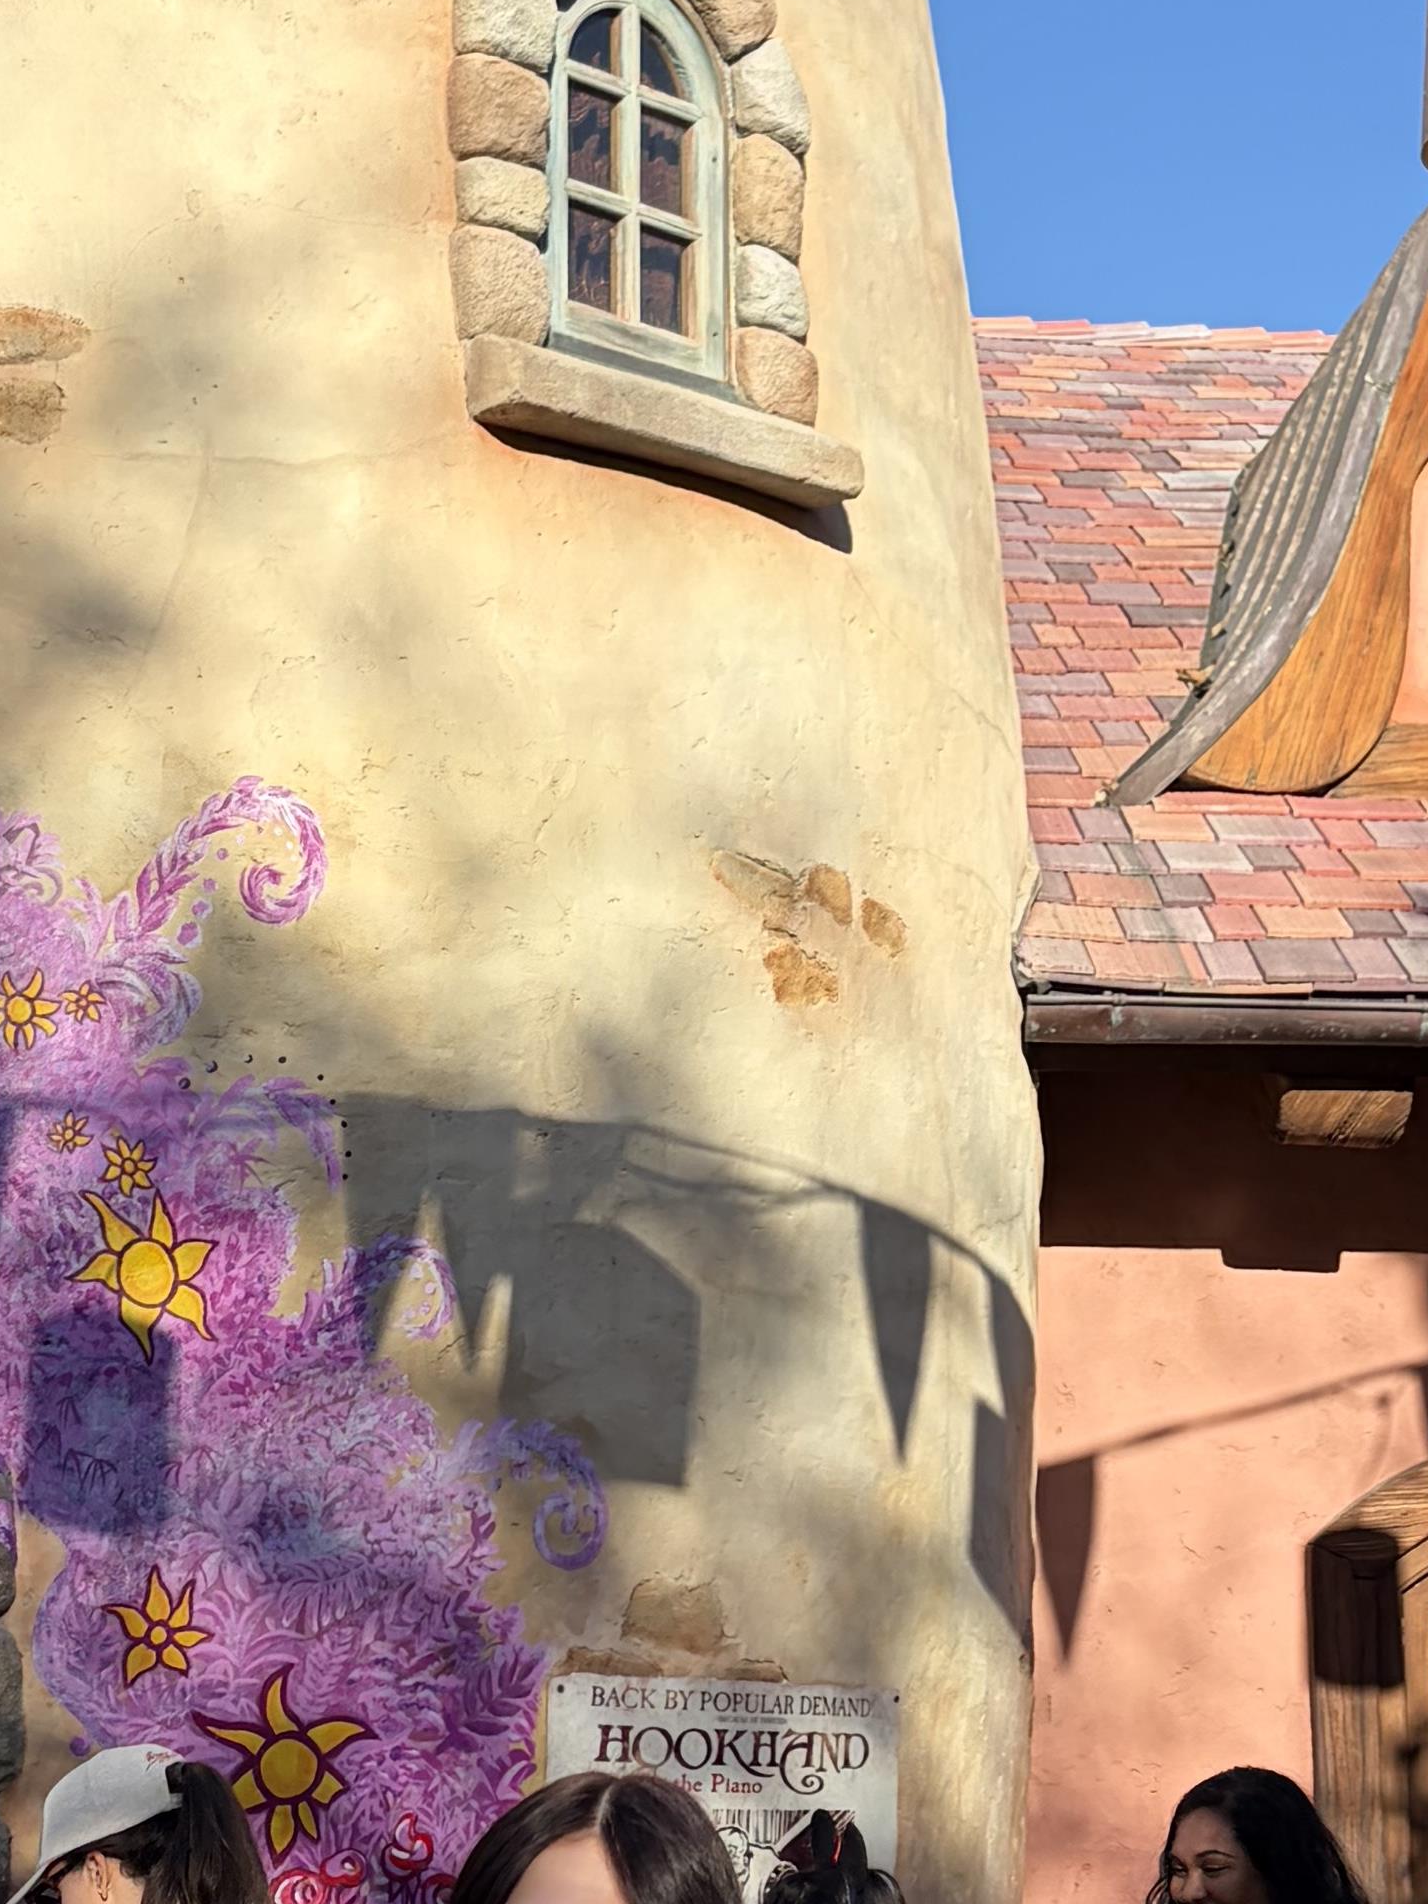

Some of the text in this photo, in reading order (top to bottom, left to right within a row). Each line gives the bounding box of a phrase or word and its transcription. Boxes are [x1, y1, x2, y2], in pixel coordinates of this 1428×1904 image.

[591, 1685, 872, 1718] BACK BY POPULAR DEMAND
[594, 1723, 870, 1796] HOOKHAND
[711, 1773, 763, 1794] Piano
